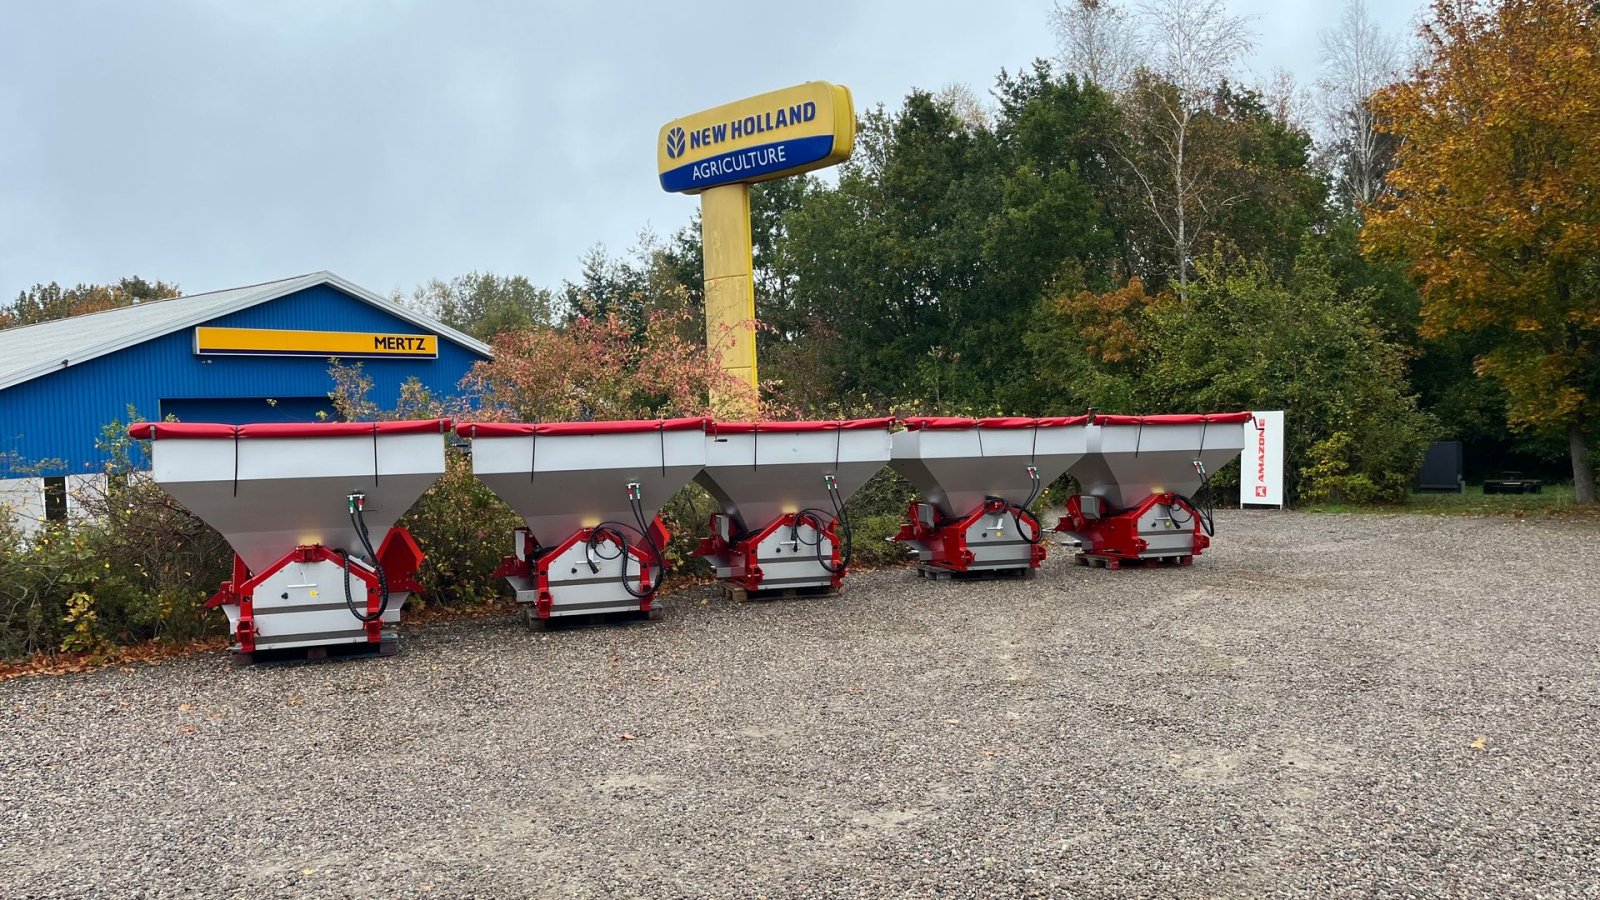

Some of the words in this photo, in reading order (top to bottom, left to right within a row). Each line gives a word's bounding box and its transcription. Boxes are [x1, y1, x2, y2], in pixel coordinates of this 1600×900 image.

[690, 123, 727, 149] NEW
[731, 101, 816, 140] HOLLAND
[692, 145, 786, 181] AGRICULTURE
[374, 336, 426, 351] MERTZ
